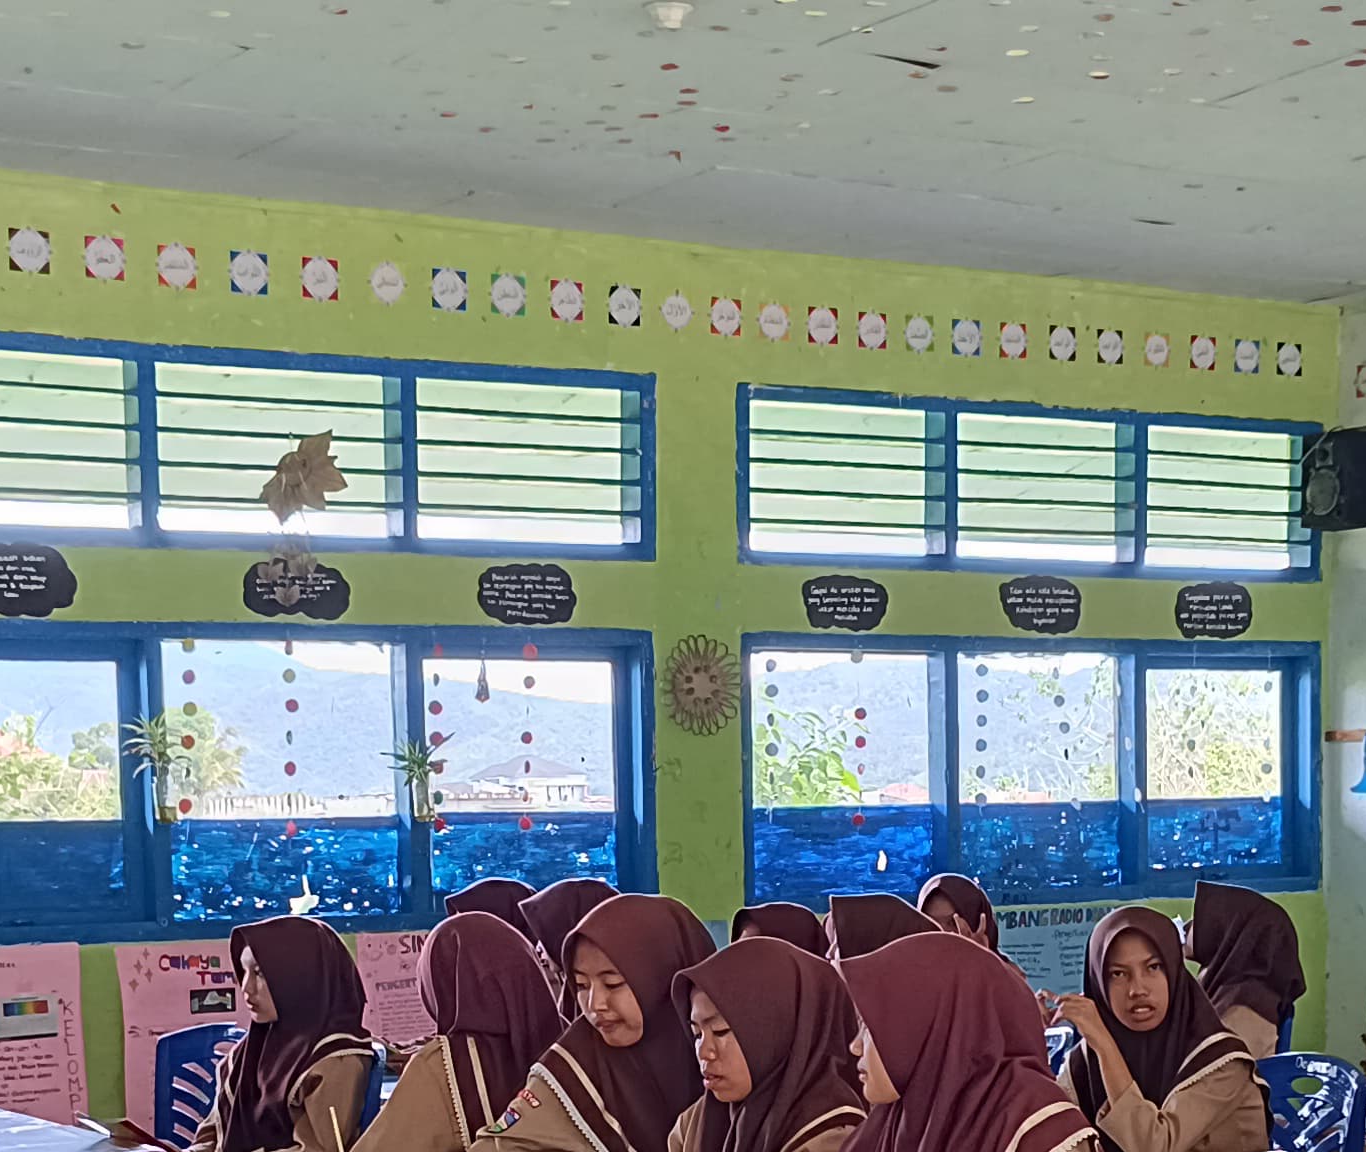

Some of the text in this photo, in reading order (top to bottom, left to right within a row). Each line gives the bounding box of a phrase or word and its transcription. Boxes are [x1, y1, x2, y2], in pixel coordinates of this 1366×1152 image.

[997, 909, 1048, 930] MBANG
[1050, 907, 1084, 926] RADIO
[398, 934, 429, 955] SIN
[158, 953, 222, 972] Cahaya
[195, 971, 237, 986] Tam
